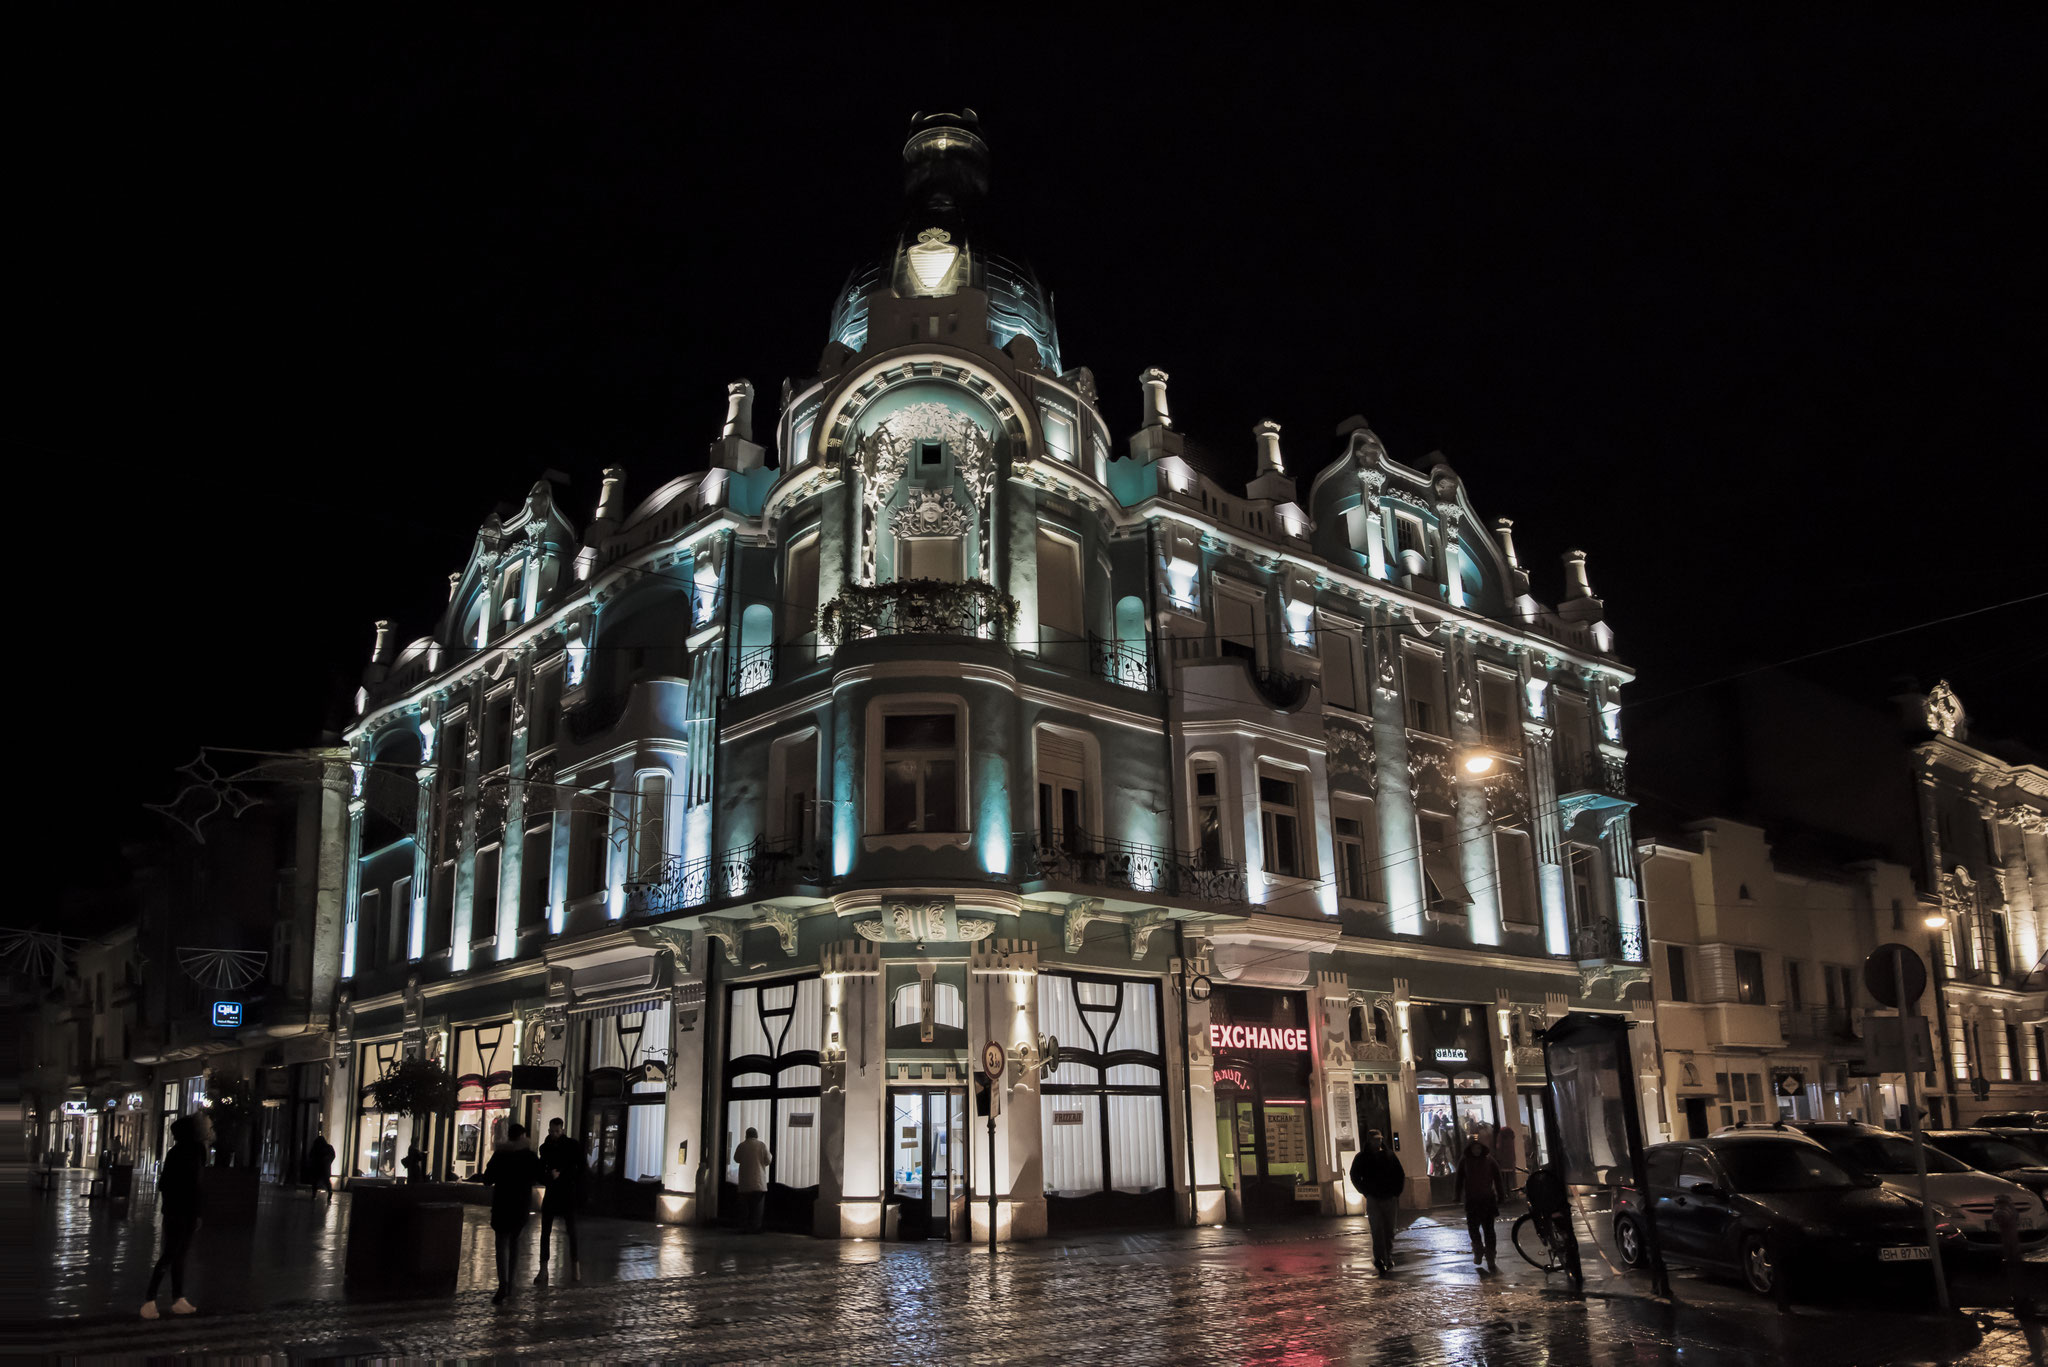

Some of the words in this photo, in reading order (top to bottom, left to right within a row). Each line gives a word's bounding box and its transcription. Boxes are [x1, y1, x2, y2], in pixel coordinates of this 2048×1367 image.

[1210, 1024, 1308, 1050] EXCHANGE
[1883, 1249, 1898, 1259] BH
[1901, 1248, 1911, 1259] 87
